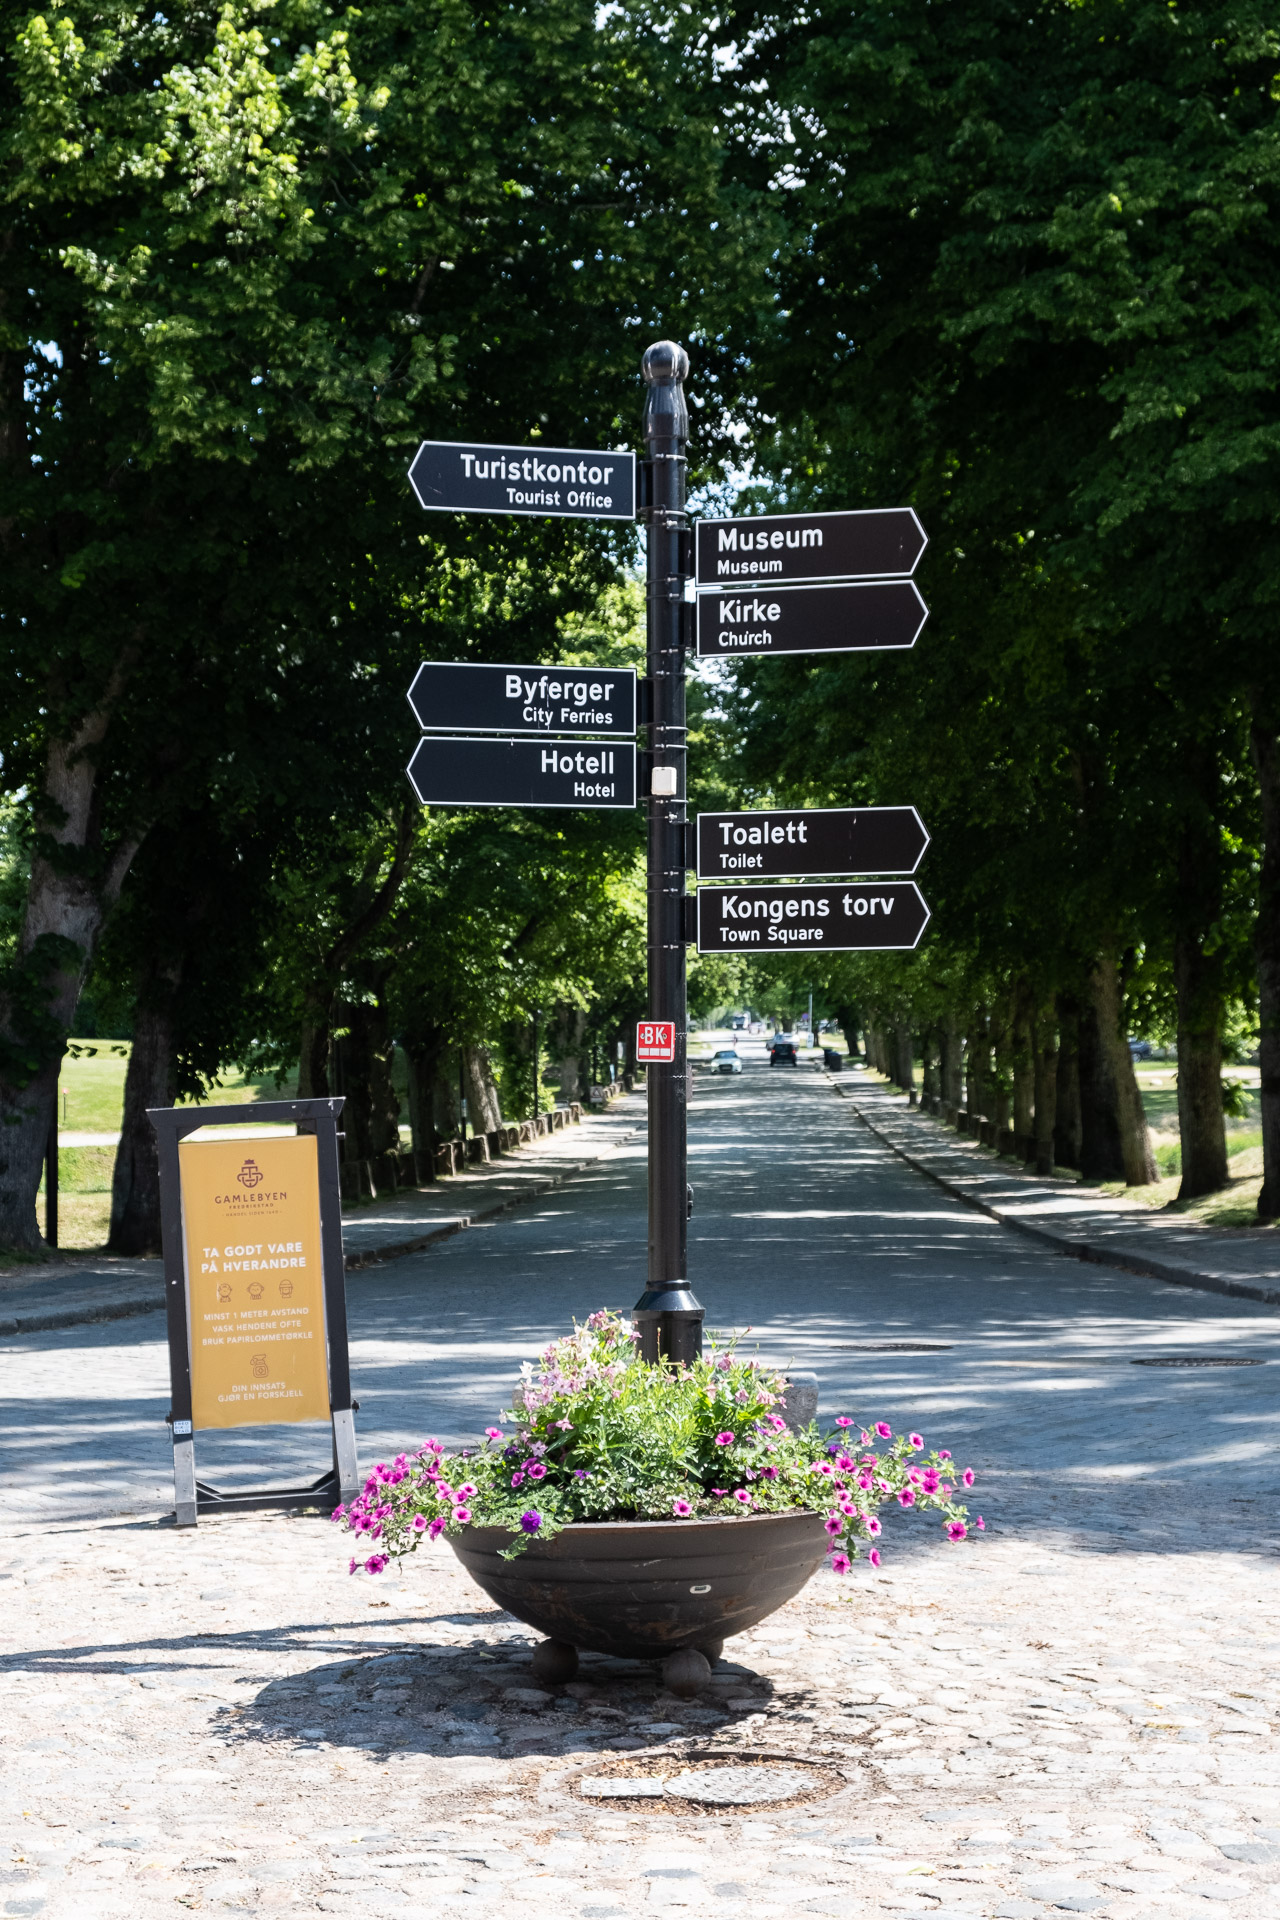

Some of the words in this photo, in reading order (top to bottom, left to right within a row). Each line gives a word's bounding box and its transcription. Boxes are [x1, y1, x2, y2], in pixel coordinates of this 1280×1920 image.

[460, 453, 614, 486] Turistkontor
[506, 488, 561, 507] Tourist
[567, 491, 613, 508] Office
[718, 527, 823, 552] Museum
[717, 559, 783, 576] Museum
[719, 598, 782, 624] Kirke
[718, 629, 772, 647] Church
[505, 674, 615, 704] Byferger
[522, 706, 554, 727] City
[560, 707, 613, 725] Ferries
[541, 749, 615, 775] Hotell
[574, 781, 615, 798] Hotel
[718, 820, 808, 846] Toalett
[719, 852, 763, 869] Toilet
[721, 895, 830, 924] Kongens
[841, 893, 895, 917] torv
[719, 926, 761, 942] Town
[767, 925, 824, 945] Square
[644, 1026, 665, 1045] BK
[214, 1192, 287, 1204] GAMLEBYEN
[203, 1247, 220, 1258] TA
[224, 1244, 263, 1257] GODT
[267, 1242, 303, 1254] VARE
[201, 1260, 218, 1274] PÅ
[223, 1257, 306, 1272] HVERANDRE
[203, 1312, 230, 1321] MINST
[240, 1310, 268, 1319] METER
[270, 1307, 309, 1316] AVSTAND
[212, 1325, 234, 1333] VASK
[236, 1322, 277, 1331] HENDENE
[279, 1320, 302, 1328] OFTE
[202, 1337, 224, 1346] BRUK
[226, 1332, 313, 1344] PAPIRLOMMETØRKLE
[217, 1394, 241, 1403] GJØR
[243, 1393, 255, 1401] EN
[257, 1390, 304, 1399] FORSKJELL
[232, 1384, 248, 1393] DIN
[250, 1382, 286, 1391] INNSATS
